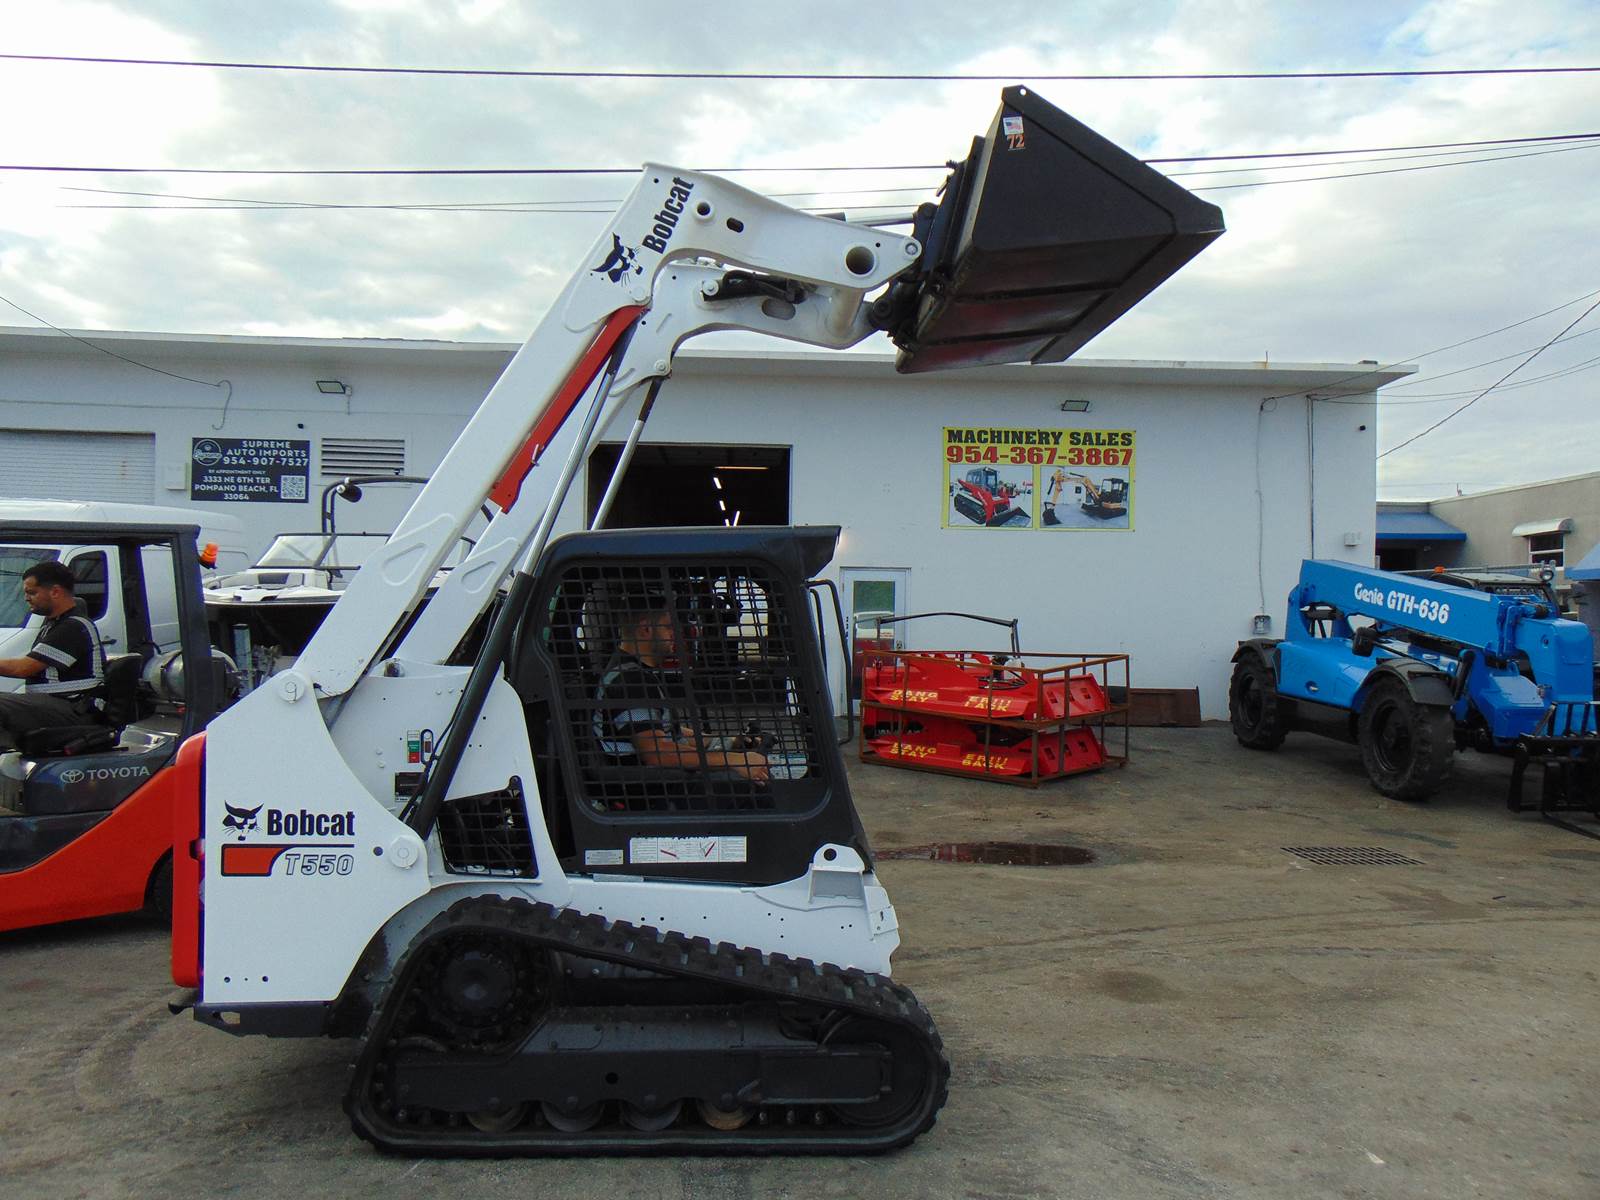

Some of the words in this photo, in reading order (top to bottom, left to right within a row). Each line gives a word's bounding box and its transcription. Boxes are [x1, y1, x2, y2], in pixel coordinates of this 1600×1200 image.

[1006, 134, 1025, 149] 72
[642, 176, 694, 254] Bobcat
[242, 440, 291, 449] SUPREME
[947, 429, 1063, 445] MACHINERY
[1069, 432, 1133, 446] SALES
[226, 448, 256, 456] AUTO
[259, 449, 307, 457] IMPORTS
[946, 445, 1133, 466] 954-367-3867
[223, 456, 309, 466] 954-907-7527
[237, 476, 254, 484] 6TH
[194, 484, 236, 492] POMPANO
[269, 485, 279, 493] FL
[1354, 582, 1384, 606] Genie
[1387, 590, 1450, 624] GTH-636
[87, 766, 150, 780] TOYOTA
[267, 809, 355, 836] Bobcat
[285, 853, 354, 876] T550
